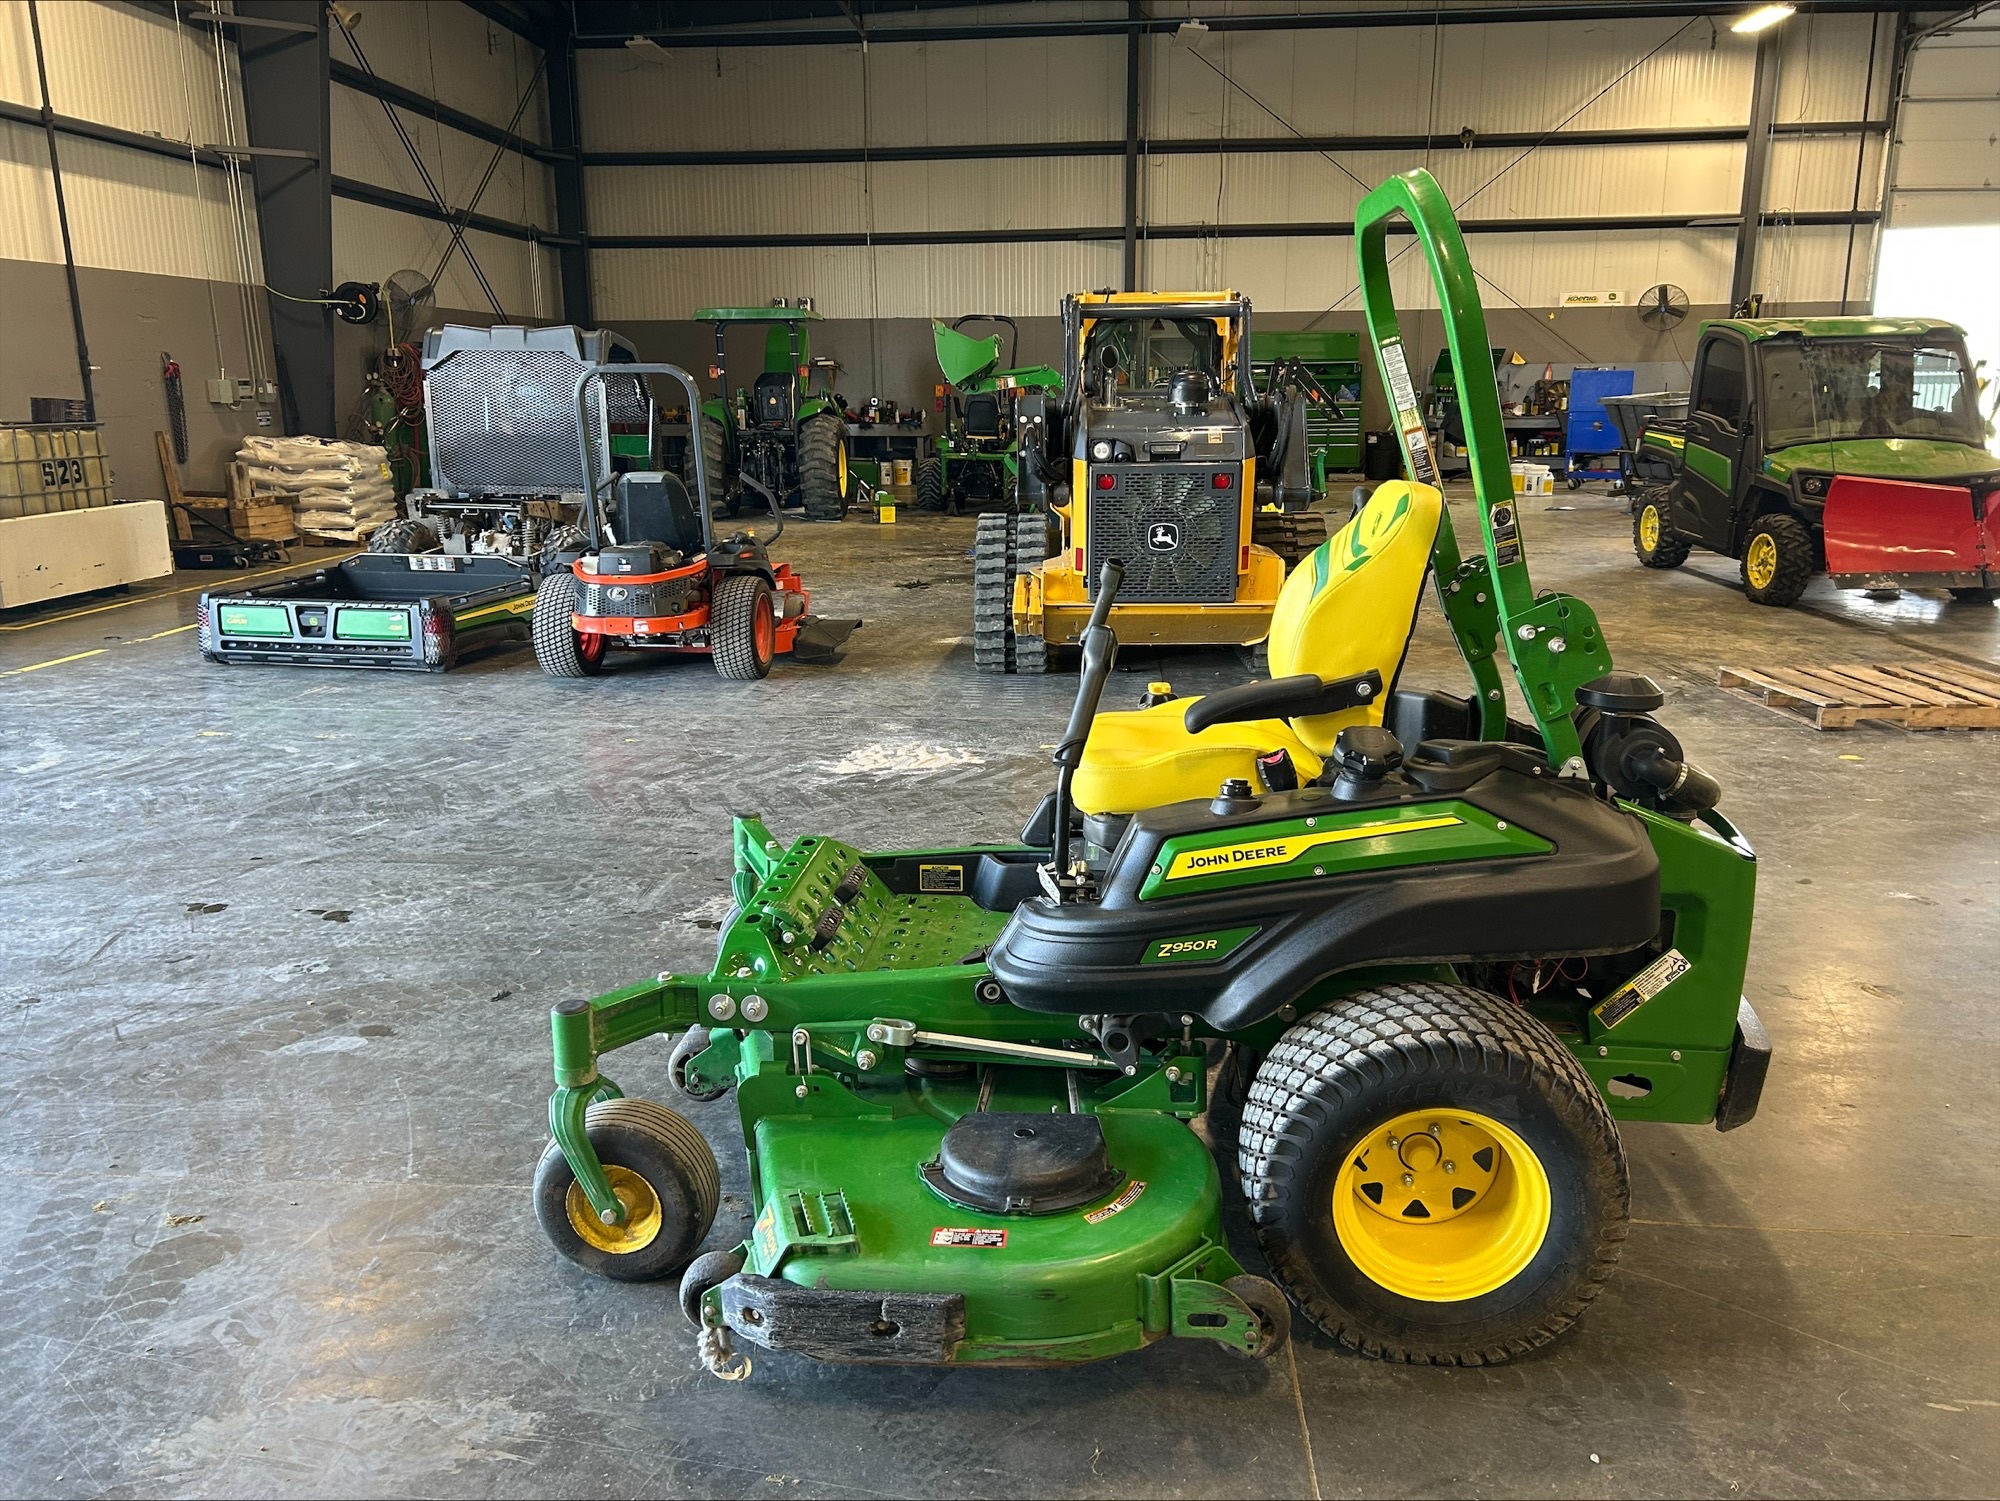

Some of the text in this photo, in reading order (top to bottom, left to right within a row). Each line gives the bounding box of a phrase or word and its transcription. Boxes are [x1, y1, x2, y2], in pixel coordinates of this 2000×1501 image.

[42, 460, 82, 486] S23
[1187, 845, 1287, 869] JOHN DEERE
[1157, 939, 1217, 958] Z950R
[1386, 1081, 1518, 1110] KENDA
